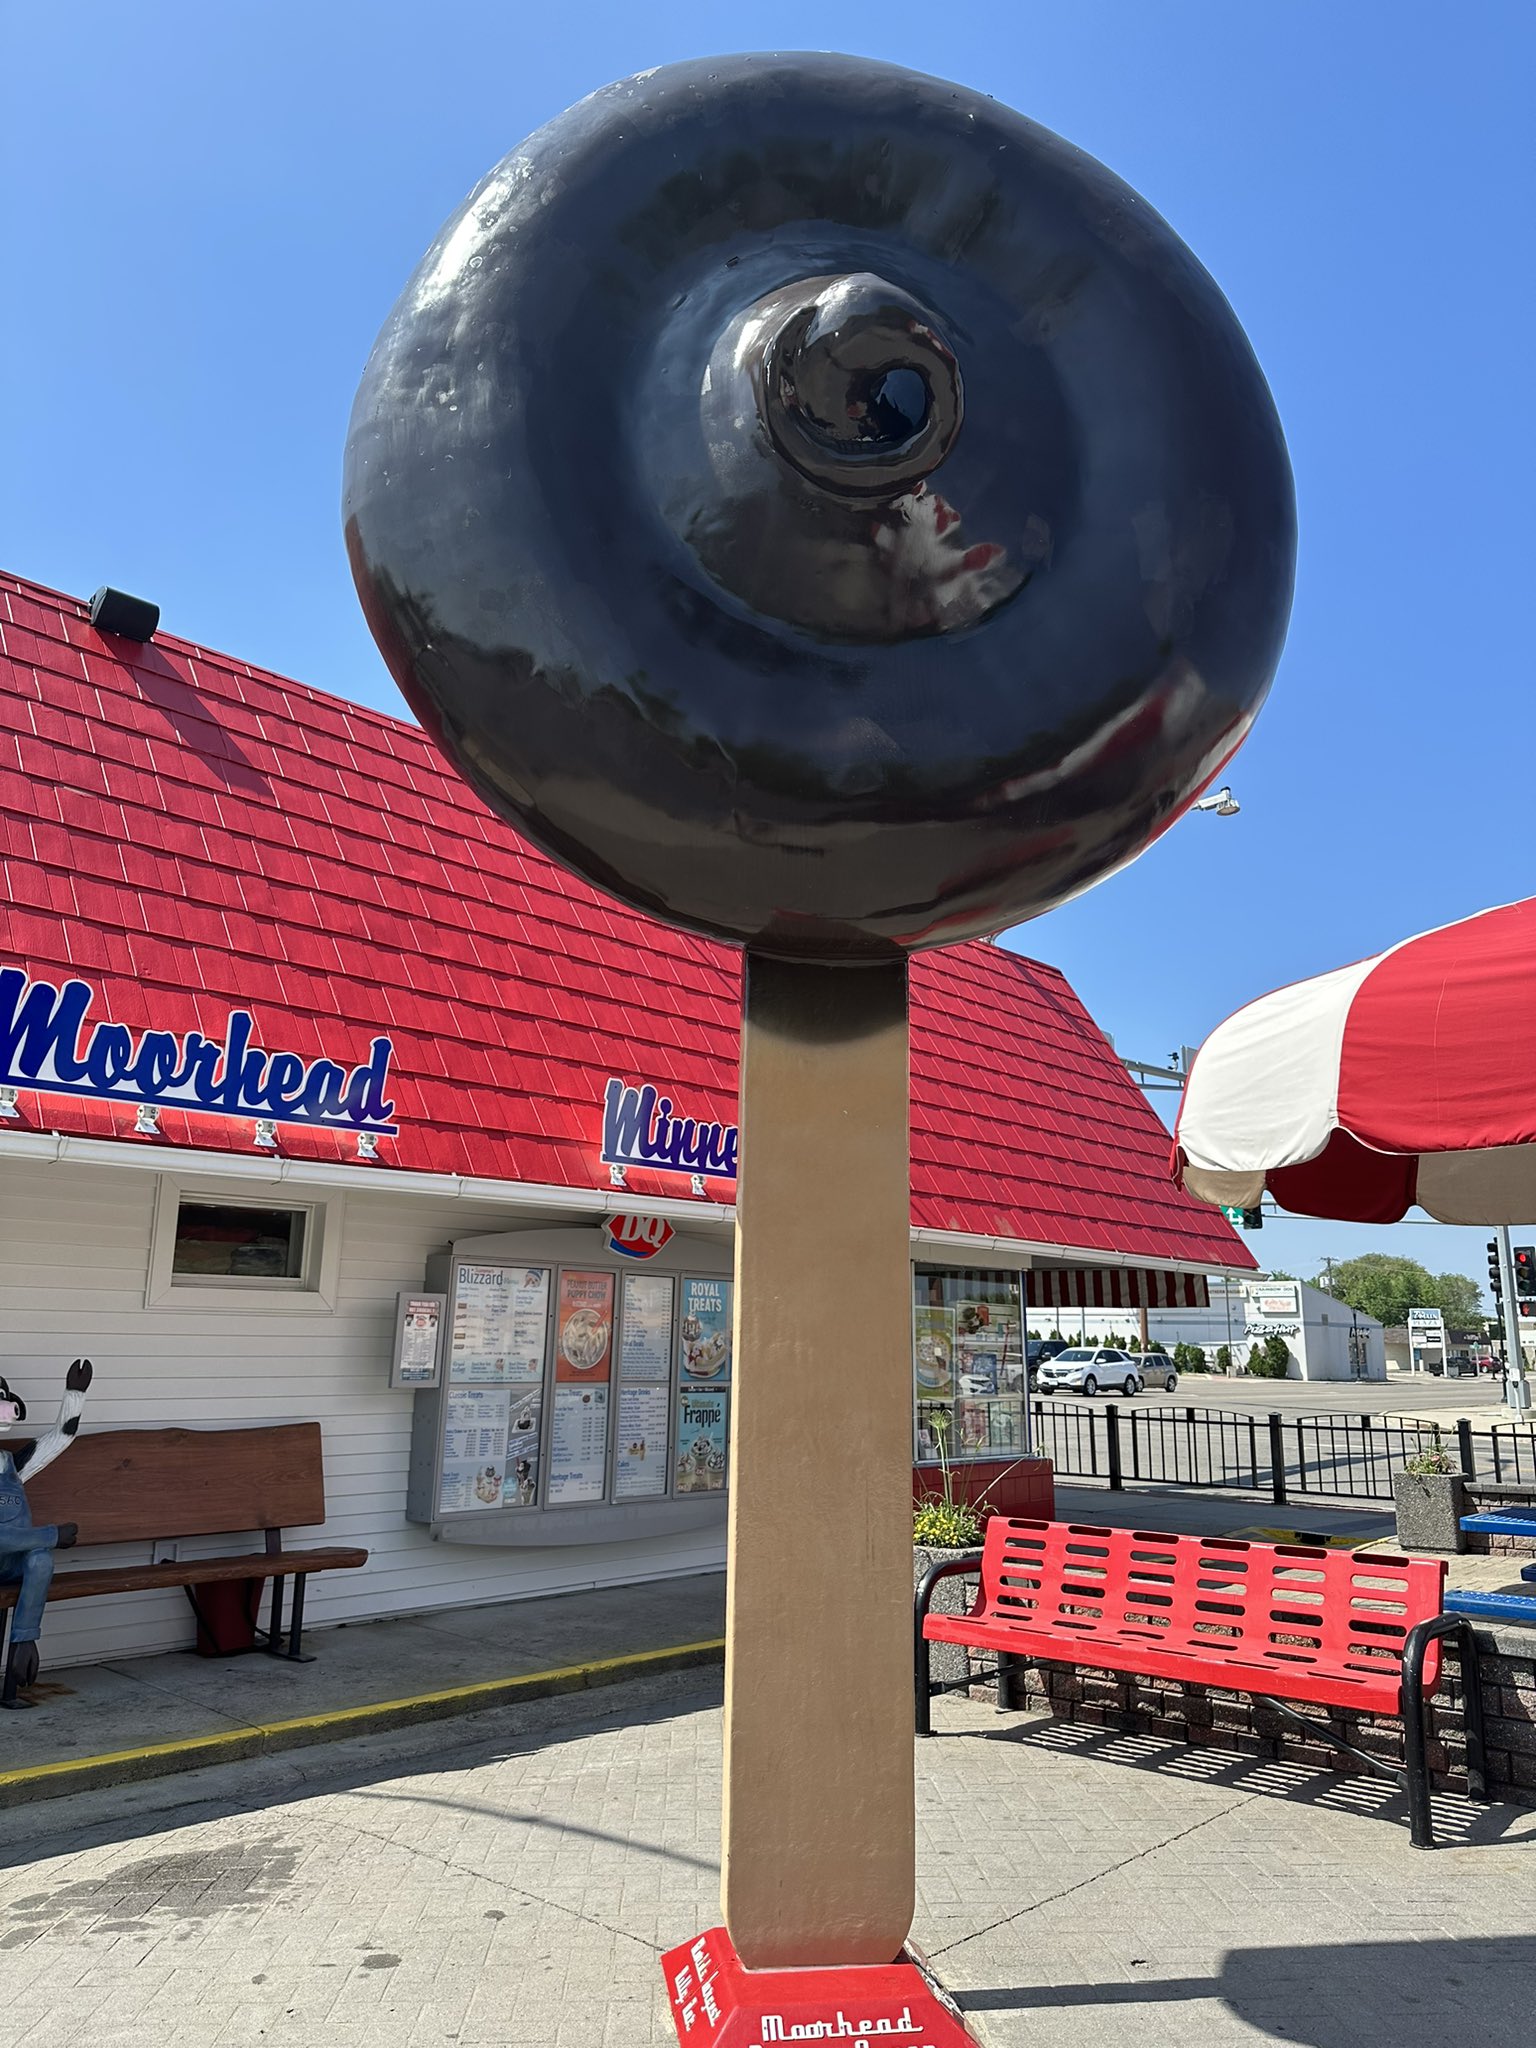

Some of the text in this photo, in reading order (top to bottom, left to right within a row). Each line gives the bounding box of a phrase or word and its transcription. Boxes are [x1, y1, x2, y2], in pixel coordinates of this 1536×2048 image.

[0, 967, 396, 1123] Moorhead
[618, 1214, 662, 1249] DQ
[459, 1267, 504, 1287] Blizzard
[691, 1282, 720, 1297] ROYAL
[687, 1296, 722, 1312] TREATS
[1244, 1323, 1298, 1335] Pizza Hut
[683, 1402, 721, 1428] Frappé
[760, 2006, 924, 2042] Moorhead
